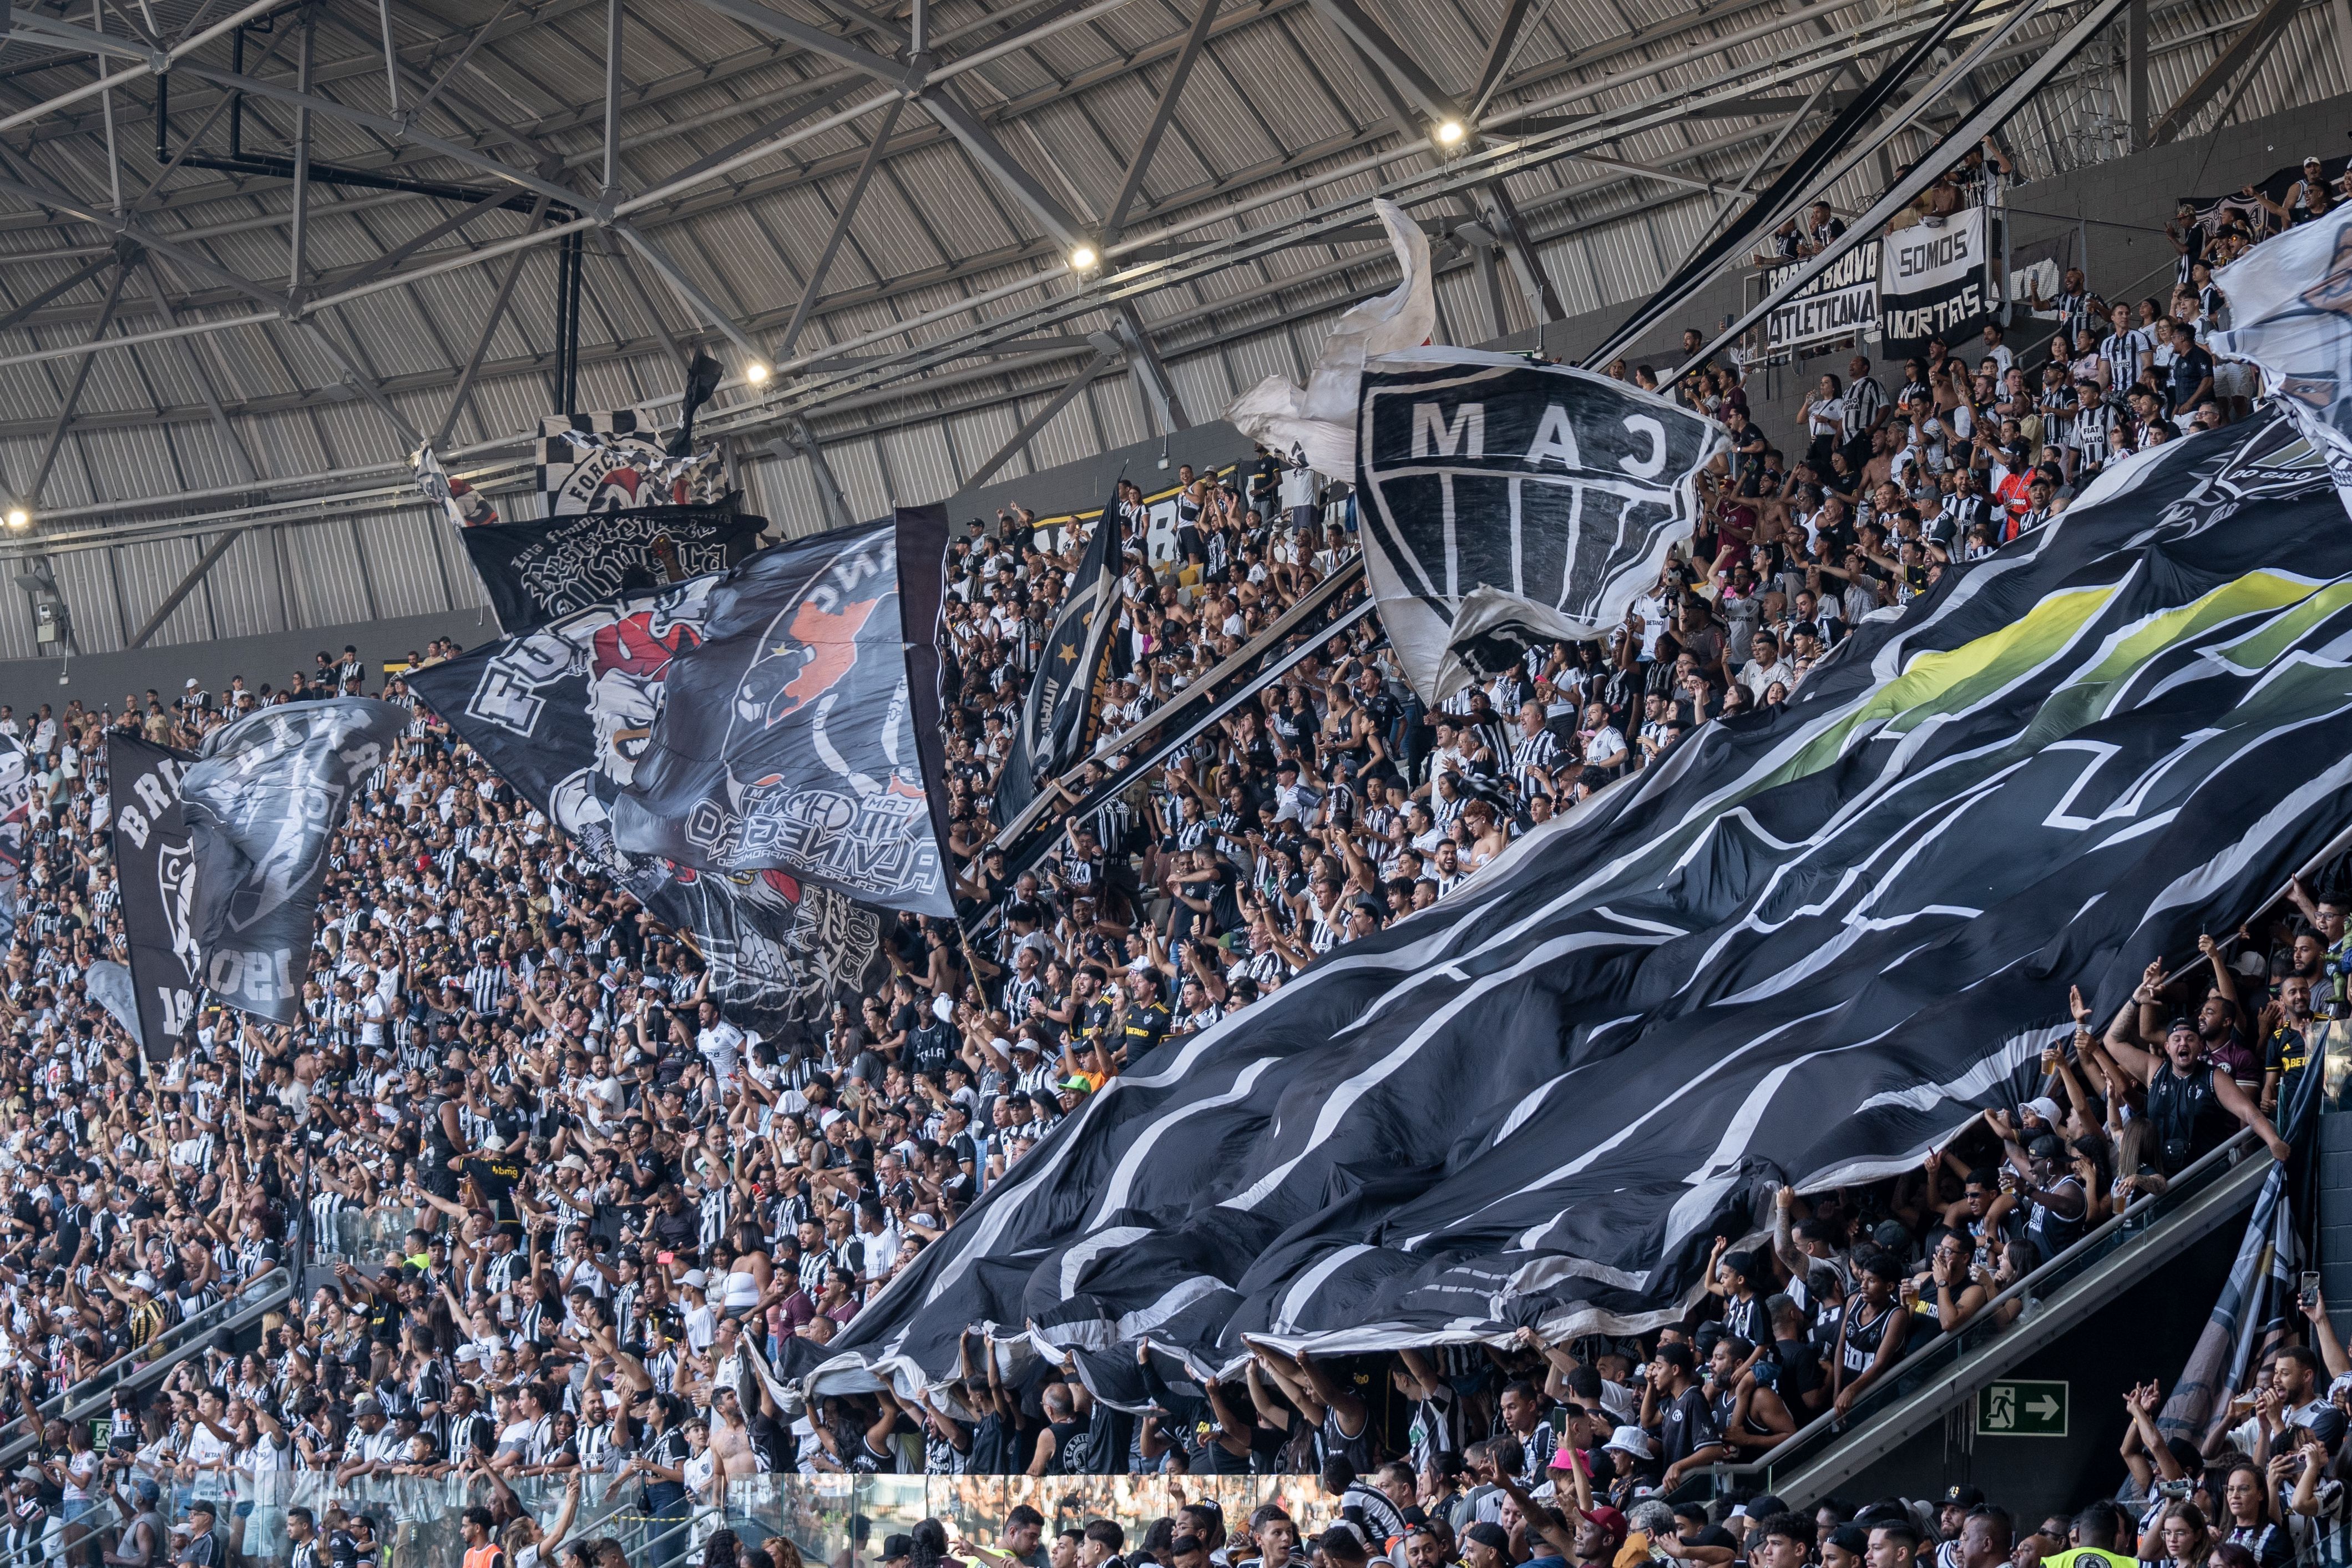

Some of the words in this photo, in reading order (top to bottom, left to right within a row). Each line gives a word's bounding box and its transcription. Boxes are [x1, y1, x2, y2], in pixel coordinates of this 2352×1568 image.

[1900, 229, 1968, 277] SOMOS
[1823, 241, 1878, 291] BRAVA
[1768, 289, 1875, 348] ATLETICANA
[2113, 360, 2131, 369] bmg
[2083, 427, 2099, 435] FIAT
[2083, 436, 2103, 444] ALIO
[2228, 469, 2258, 480] DO
[2259, 471, 2312, 480] GALO
[1128, 1028, 1149, 1037] BETANO
[498, 1166, 518, 1180] bmg
[572, 1274, 598, 1285] BETANO
[581, 1452, 604, 1461] BETANO
